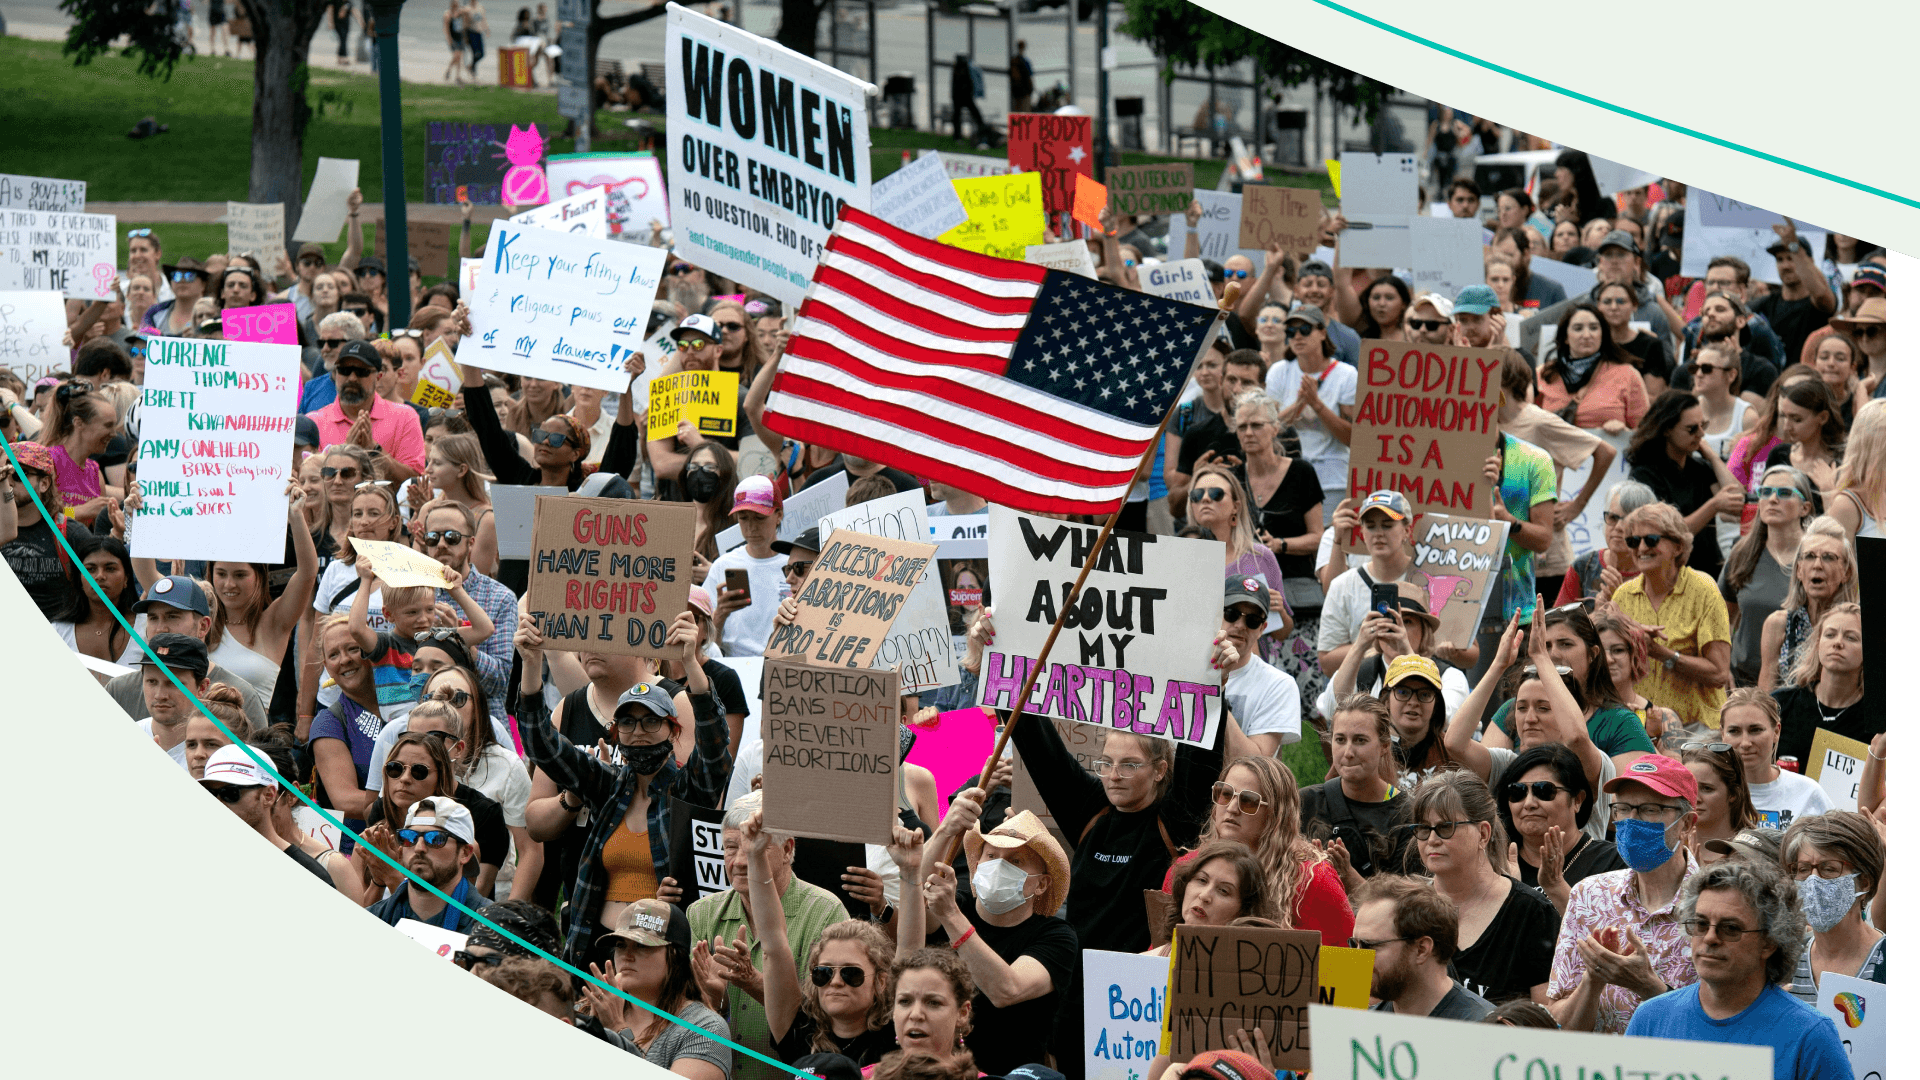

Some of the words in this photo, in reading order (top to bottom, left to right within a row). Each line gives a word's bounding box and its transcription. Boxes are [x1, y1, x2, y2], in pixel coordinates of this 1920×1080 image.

[1010, 116, 1034, 141] MY
[1039, 116, 1089, 142] BODY
[682, 134, 740, 190] OVER
[1033, 141, 1056, 169] IS
[1111, 171, 1136, 191] NO
[1137, 170, 1186, 188] UTERUS
[1112, 193, 1138, 216] NO
[11, 212, 36, 227] TIRED
[48, 214, 57, 228] OF
[62, 215, 111, 233] EVERYONE
[683, 188, 701, 212] NO
[705, 196, 773, 239] QUESTION.
[776, 222, 797, 249] END
[800, 234, 813, 258] OF
[66, 232, 101, 250] RIGHTS
[33, 249, 48, 267] MY
[57, 251, 85, 268] BODY
[494, 230, 539, 280] Keep
[548, 255, 577, 279] your
[584, 252, 622, 294] filthy
[629, 266, 656, 289] laws
[706, 235, 761, 268] transgender
[762, 257, 788, 280] people
[789, 270, 806, 289] with
[23, 266, 43, 289] BUT
[50, 268, 69, 290] ME
[1149, 266, 1193, 286] Girls
[226, 312, 289, 339] STOP
[510, 295, 562, 323] religious
[570, 306, 602, 325] paws
[613, 316, 637, 331] out
[29, 334, 50, 356] of
[483, 329, 499, 344] of
[192, 371, 269, 392] THOMASS
[650, 373, 710, 397] ABORTION
[1368, 348, 1499, 398] BODILY
[145, 389, 196, 410] BRETT
[650, 397, 661, 413] IS
[664, 395, 670, 409] A
[674, 389, 720, 406] HUMAN
[1356, 392, 1497, 434] AUTONOMY
[650, 408, 680, 430] RIGHT
[140, 439, 179, 459] AMY
[182, 439, 260, 459] CONEHEAD
[1377, 434, 1416, 466] IS
[1422, 439, 1444, 470] A
[182, 462, 224, 477] BARF
[137, 480, 194, 497] SAMUEL
[229, 481, 236, 496] L
[1351, 468, 1475, 510] HUMAN
[137, 502, 165, 516] Neil
[783, 494, 830, 535] FIGHT
[573, 508, 648, 546] GUNS
[821, 504, 921, 546] Artion
[1425, 522, 1492, 545] MIND
[1017, 517, 1157, 575] WHAT
[1414, 543, 1458, 567] YOUR
[1458, 553, 1492, 572] OWN
[537, 548, 600, 576] HAVE
[610, 553, 675, 582] MORE
[815, 541, 883, 580] ACCESS
[884, 557, 928, 587] SAFE
[565, 579, 658, 614] RIGHTS
[800, 578, 904, 622] ABORTIONS
[950, 591, 982, 603] Suprem
[1025, 579, 1168, 635] ABOUT
[530, 612, 589, 640] THAN
[598, 614, 613, 640] I
[627, 618, 667, 649] DO
[882, 625, 951, 667] onomy
[1079, 630, 1136, 669] MY
[769, 667, 886, 699] ABORTION
[891, 651, 937, 693] ight
[769, 692, 825, 716] BANS
[833, 702, 893, 724] DON'T
[981, 651, 1221, 744] HEARTBEAT
[770, 719, 871, 747] PREVENT
[767, 745, 891, 774] ABORTIONS
[1826, 750, 1856, 775] LETS
[1094, 852, 1111, 862] EXIST
[1112, 855, 1132, 863] LOUD
[698, 860, 729, 886] WI
[635, 920, 662, 932] TEQUILA
[1178, 935, 1219, 998] MY
[1237, 939, 1319, 998] BODY
[1108, 983, 1167, 1023] Bodi
[1178, 1007, 1213, 1055] MY
[1219, 1001, 1311, 1053] CHOICE
[1350, 1034, 1418, 1080] NO
